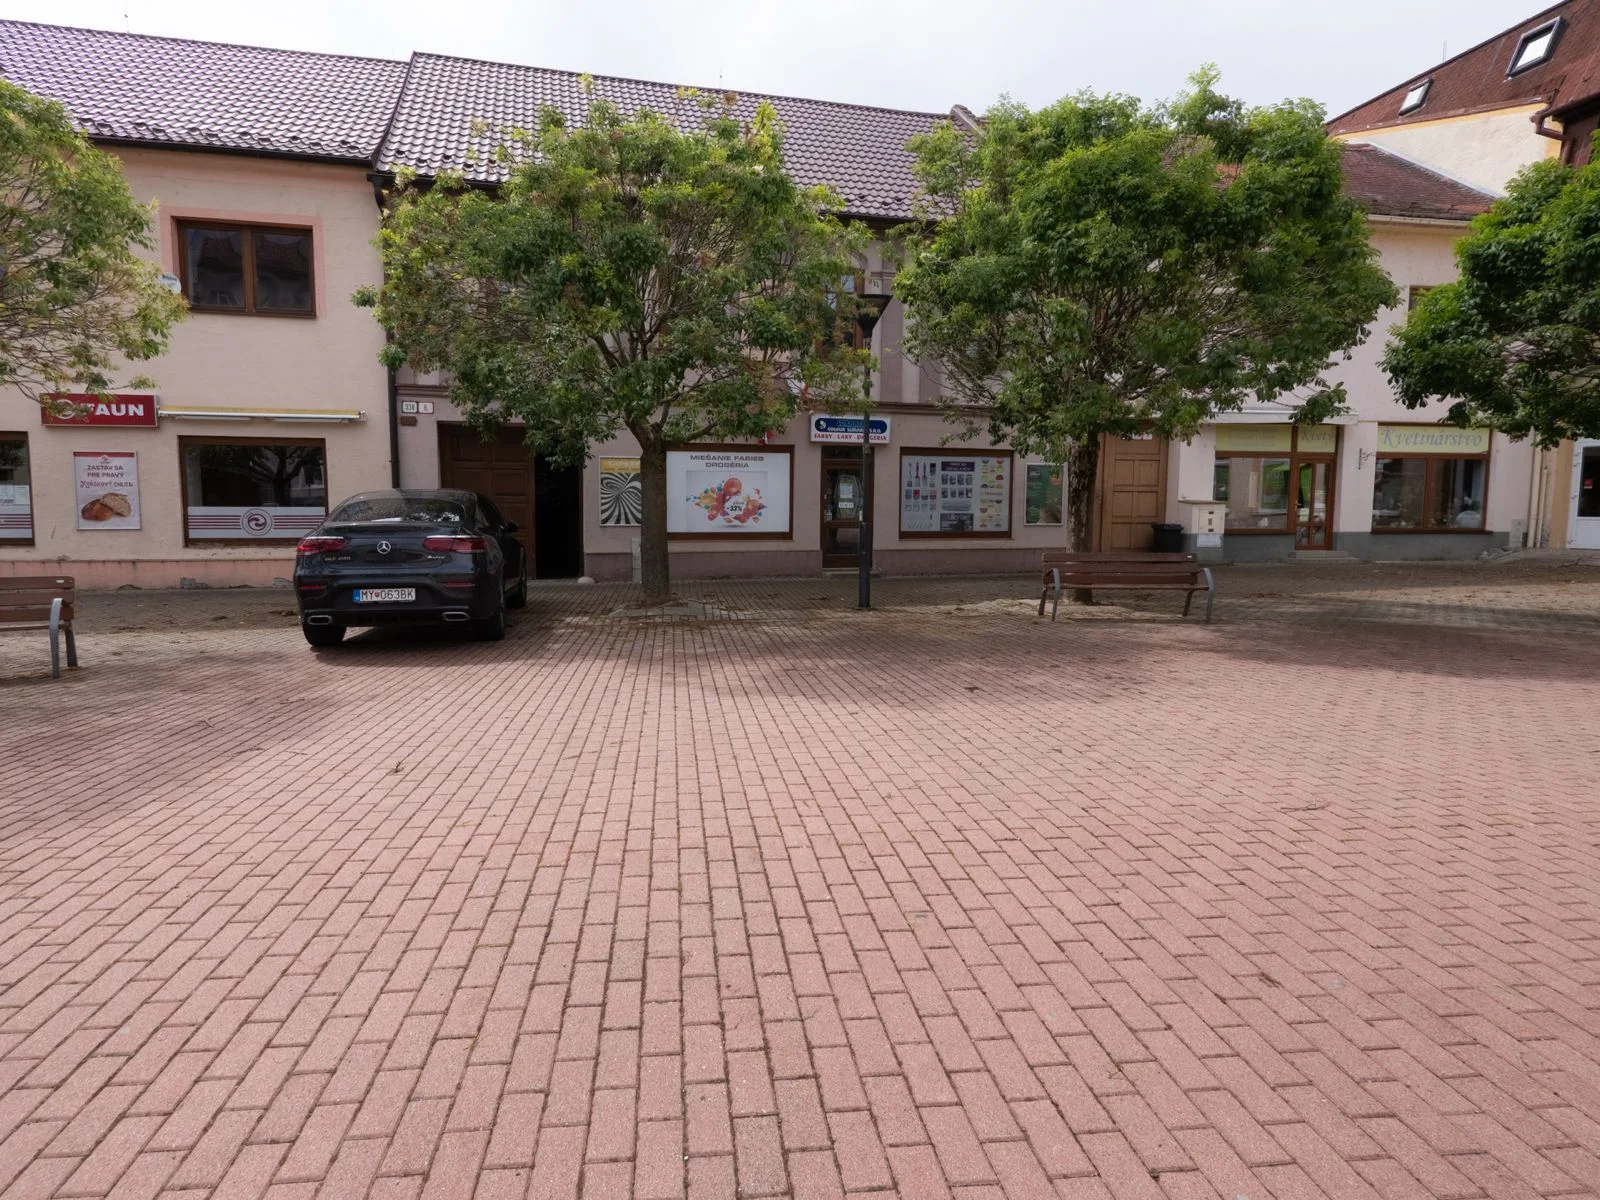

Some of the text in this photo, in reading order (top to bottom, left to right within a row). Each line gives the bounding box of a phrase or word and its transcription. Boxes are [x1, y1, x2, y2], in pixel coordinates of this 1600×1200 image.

[1383, 427, 1482, 448] Kvetinárstvo
[361, 589, 414, 600] MY 063BK
